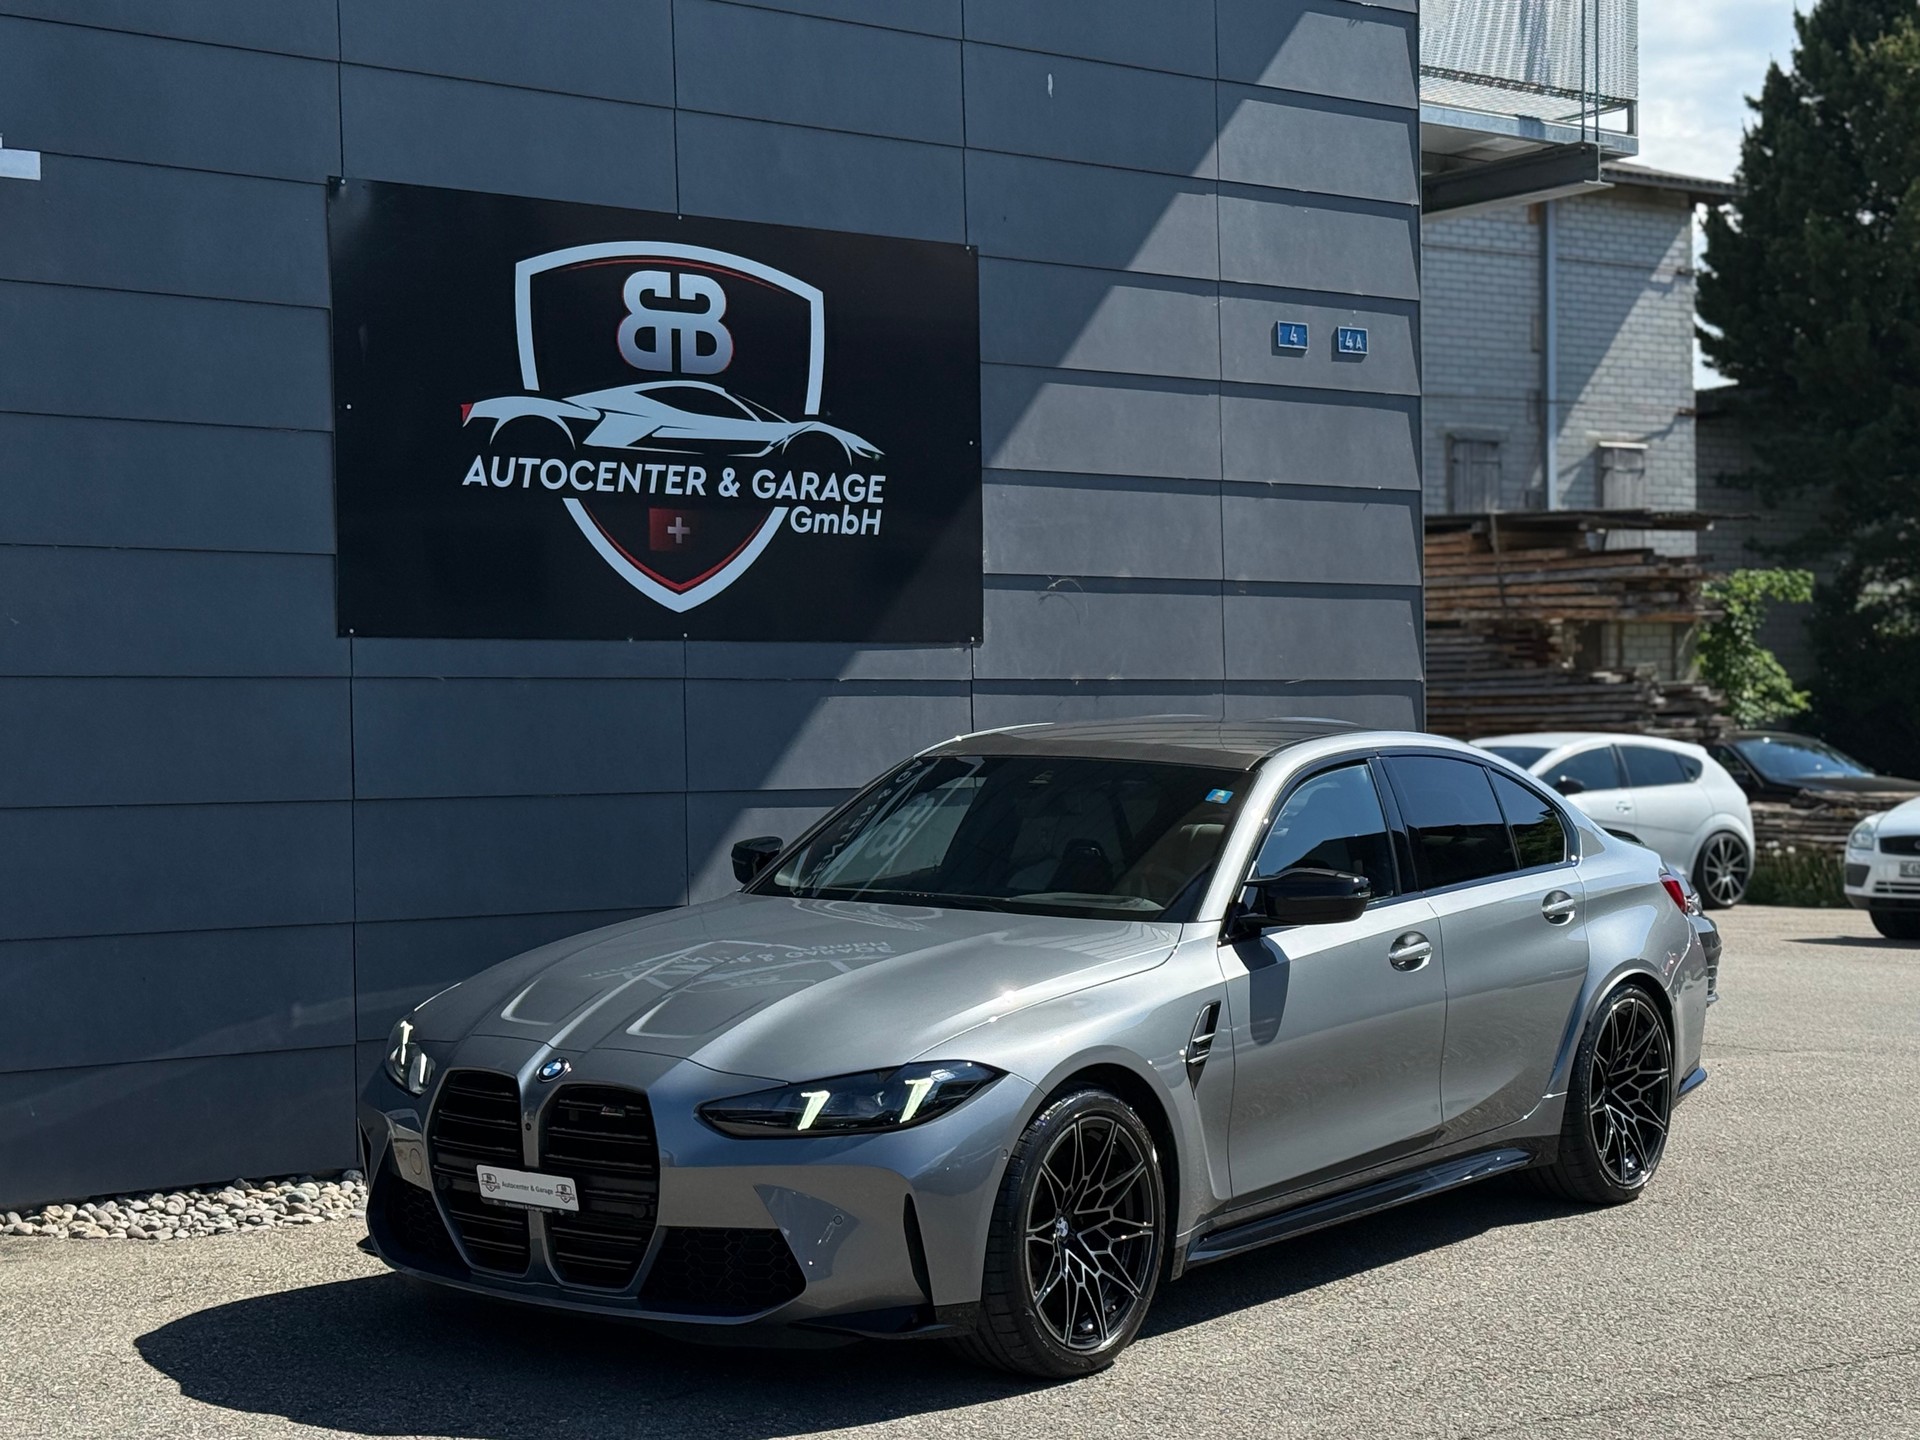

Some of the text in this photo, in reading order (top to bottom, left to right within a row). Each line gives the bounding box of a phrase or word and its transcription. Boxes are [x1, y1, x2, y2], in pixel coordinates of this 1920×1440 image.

[1290, 326, 1298, 343] 4
[1345, 331, 1363, 349] 4A
[462, 455, 886, 504] AUTOCENTER & GARAGE
[789, 505, 882, 536] GmbH
[502, 1181, 529, 1191] Autocenter
[535, 1185, 554, 1195] Garage
